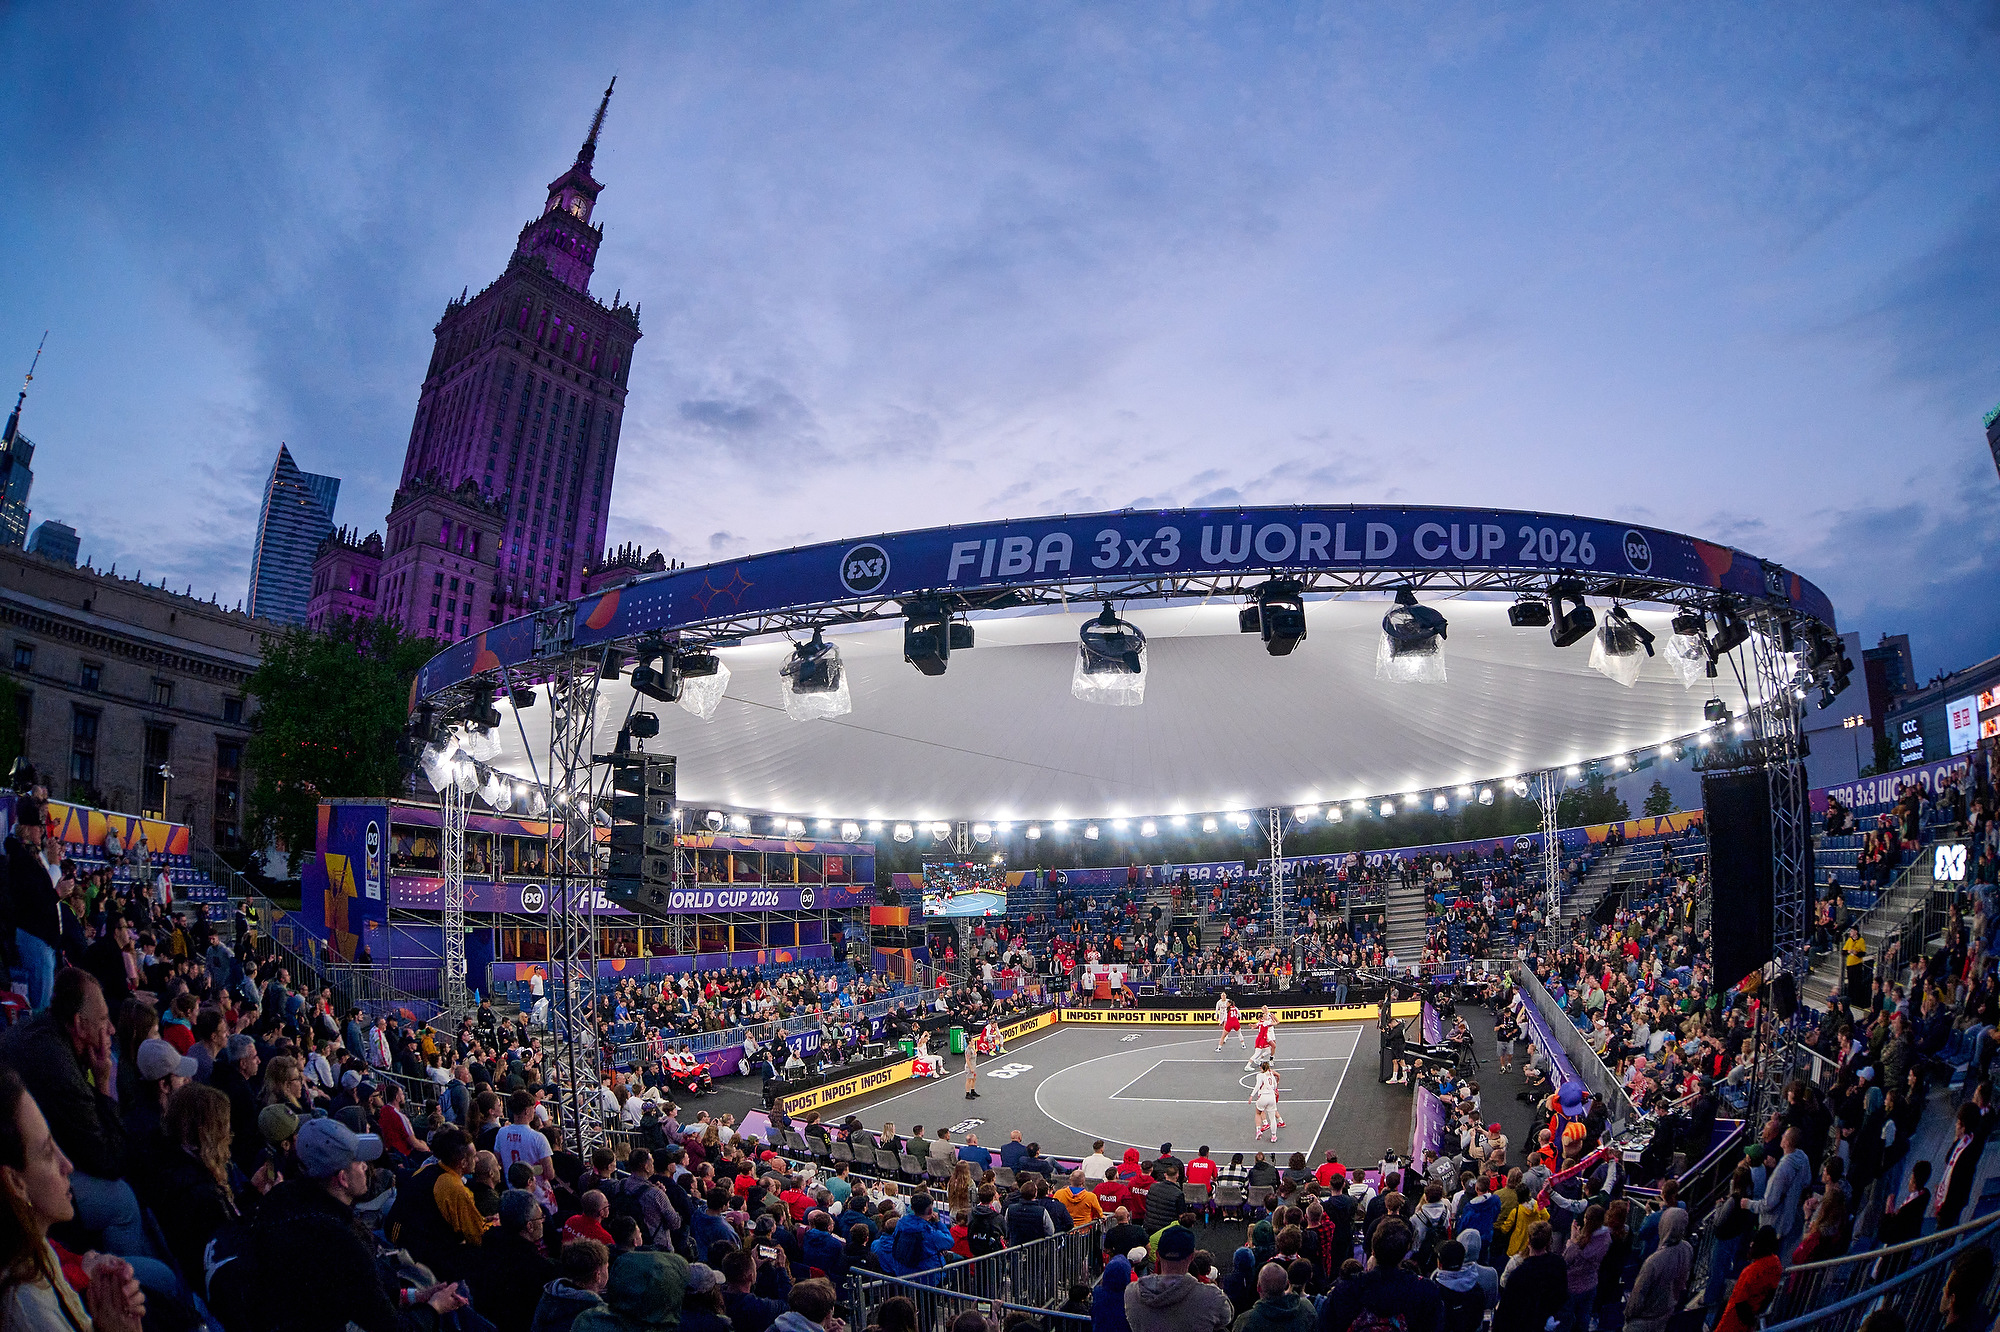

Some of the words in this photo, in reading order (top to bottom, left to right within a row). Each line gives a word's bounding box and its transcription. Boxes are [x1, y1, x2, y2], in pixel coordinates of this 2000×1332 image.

[947, 532, 1074, 581] FIBA
[1091, 526, 1181, 569] 3x3
[1201, 522, 1398, 564] WORLD
[1413, 522, 1506, 560] CUP
[1519, 525, 1596, 565] 2026
[1856, 781, 1876, 807] 3x3
[667, 891, 714, 909] ORLD
[717, 890, 748, 908] CUP
[750, 890, 779, 907] 2026
[1020, 1018, 1039, 1033] INPOST
[1067, 1011, 1103, 1021] INPOST
[1107, 1012, 1146, 1022] INPOST
[1150, 1012, 1189, 1022] INPOST
[1281, 1010, 1324, 1020] INPOST
[822, 1080, 857, 1103] INPOST
[861, 1069, 893, 1090] INPOST
[1100, 1194, 1117, 1203] POLSKA
